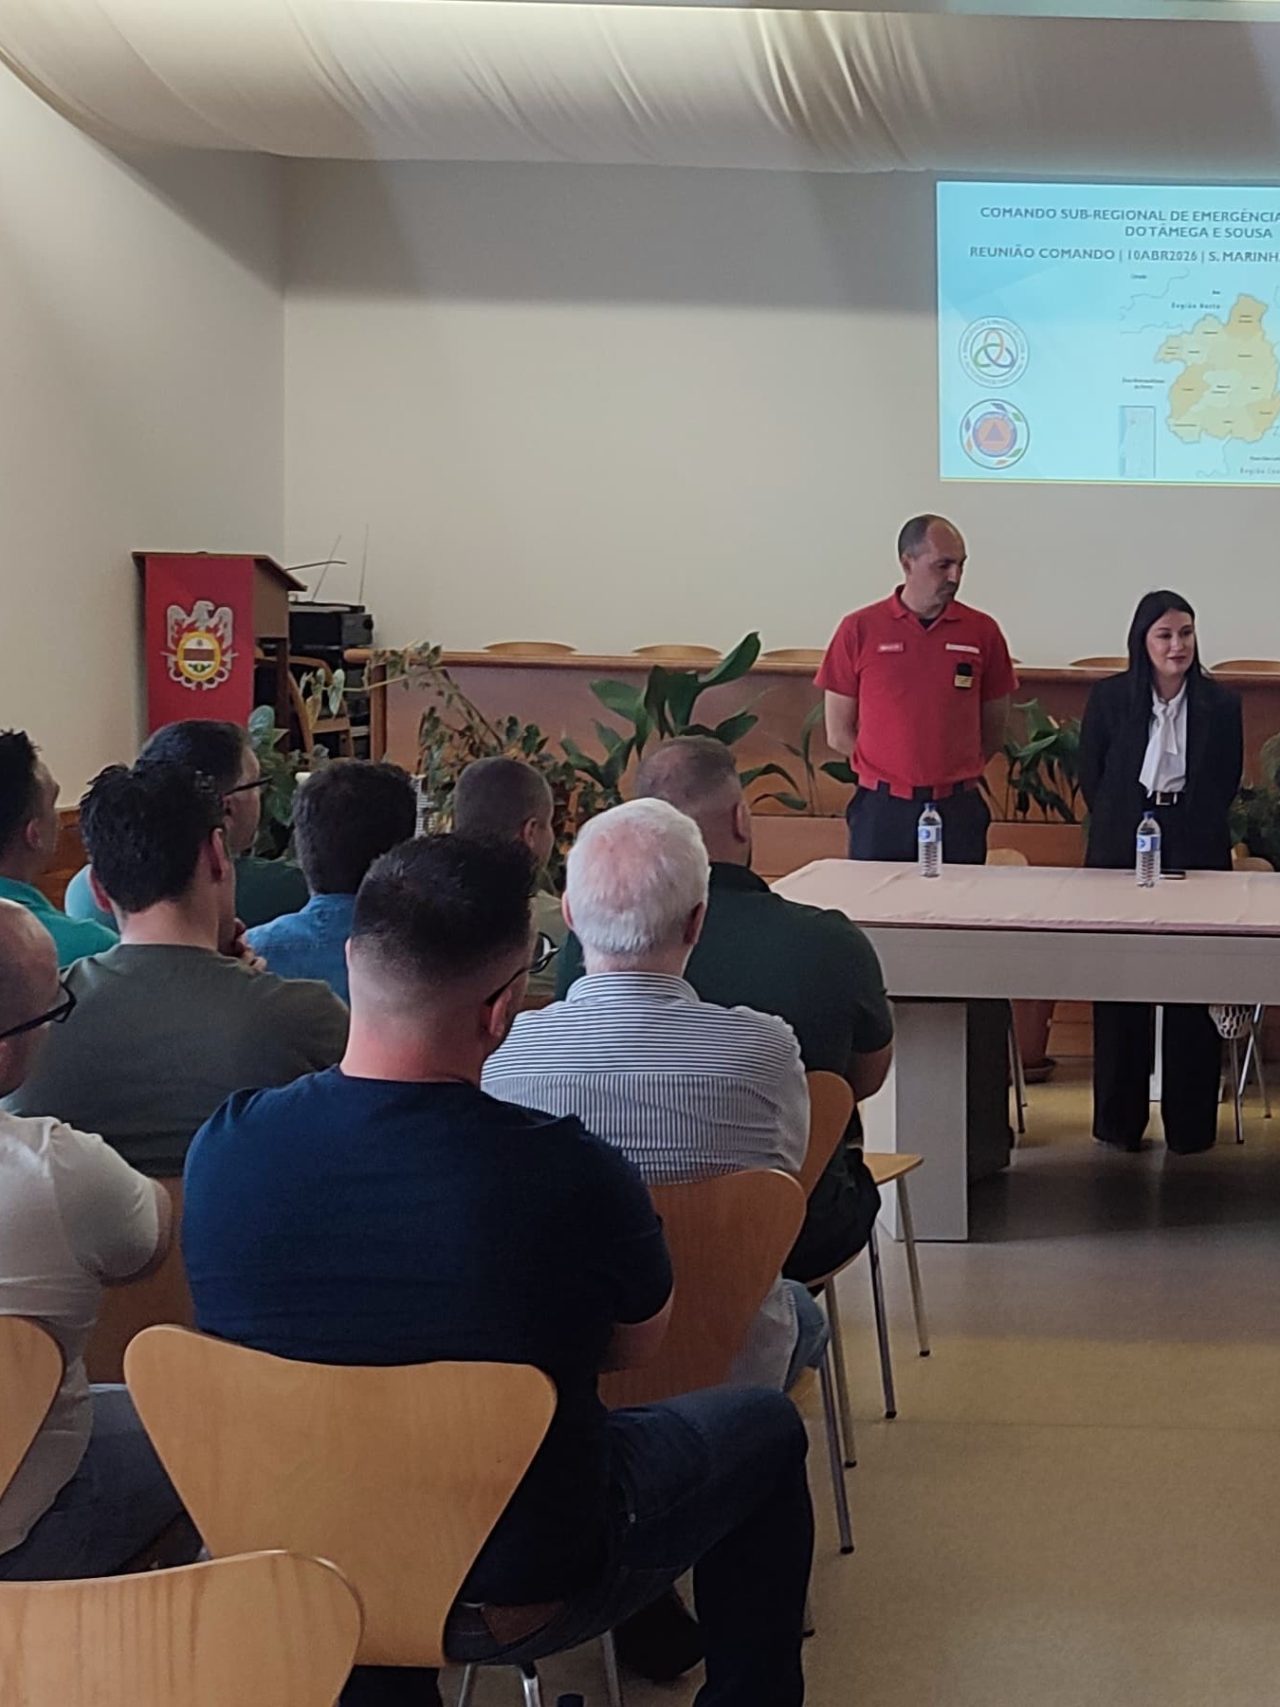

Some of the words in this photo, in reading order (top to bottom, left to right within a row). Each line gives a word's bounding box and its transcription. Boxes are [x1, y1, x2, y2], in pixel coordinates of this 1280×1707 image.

[979, 206, 1057, 220] COMANDO
[1060, 208, 1166, 221] SUB-REGIONAL
[1170, 210, 1189, 222] DE
[1125, 226, 1147, 237] DO
[1148, 223, 1208, 238] TÂMEGA
[1213, 228, 1221, 238] E
[1224, 227, 1273, 239] SOUSA
[969, 244, 1035, 258] REUNIÃO
[1038, 248, 1115, 260] COMANDO
[1127, 249, 1198, 261] 10ABR2026
[1208, 251, 1220, 262] S.
